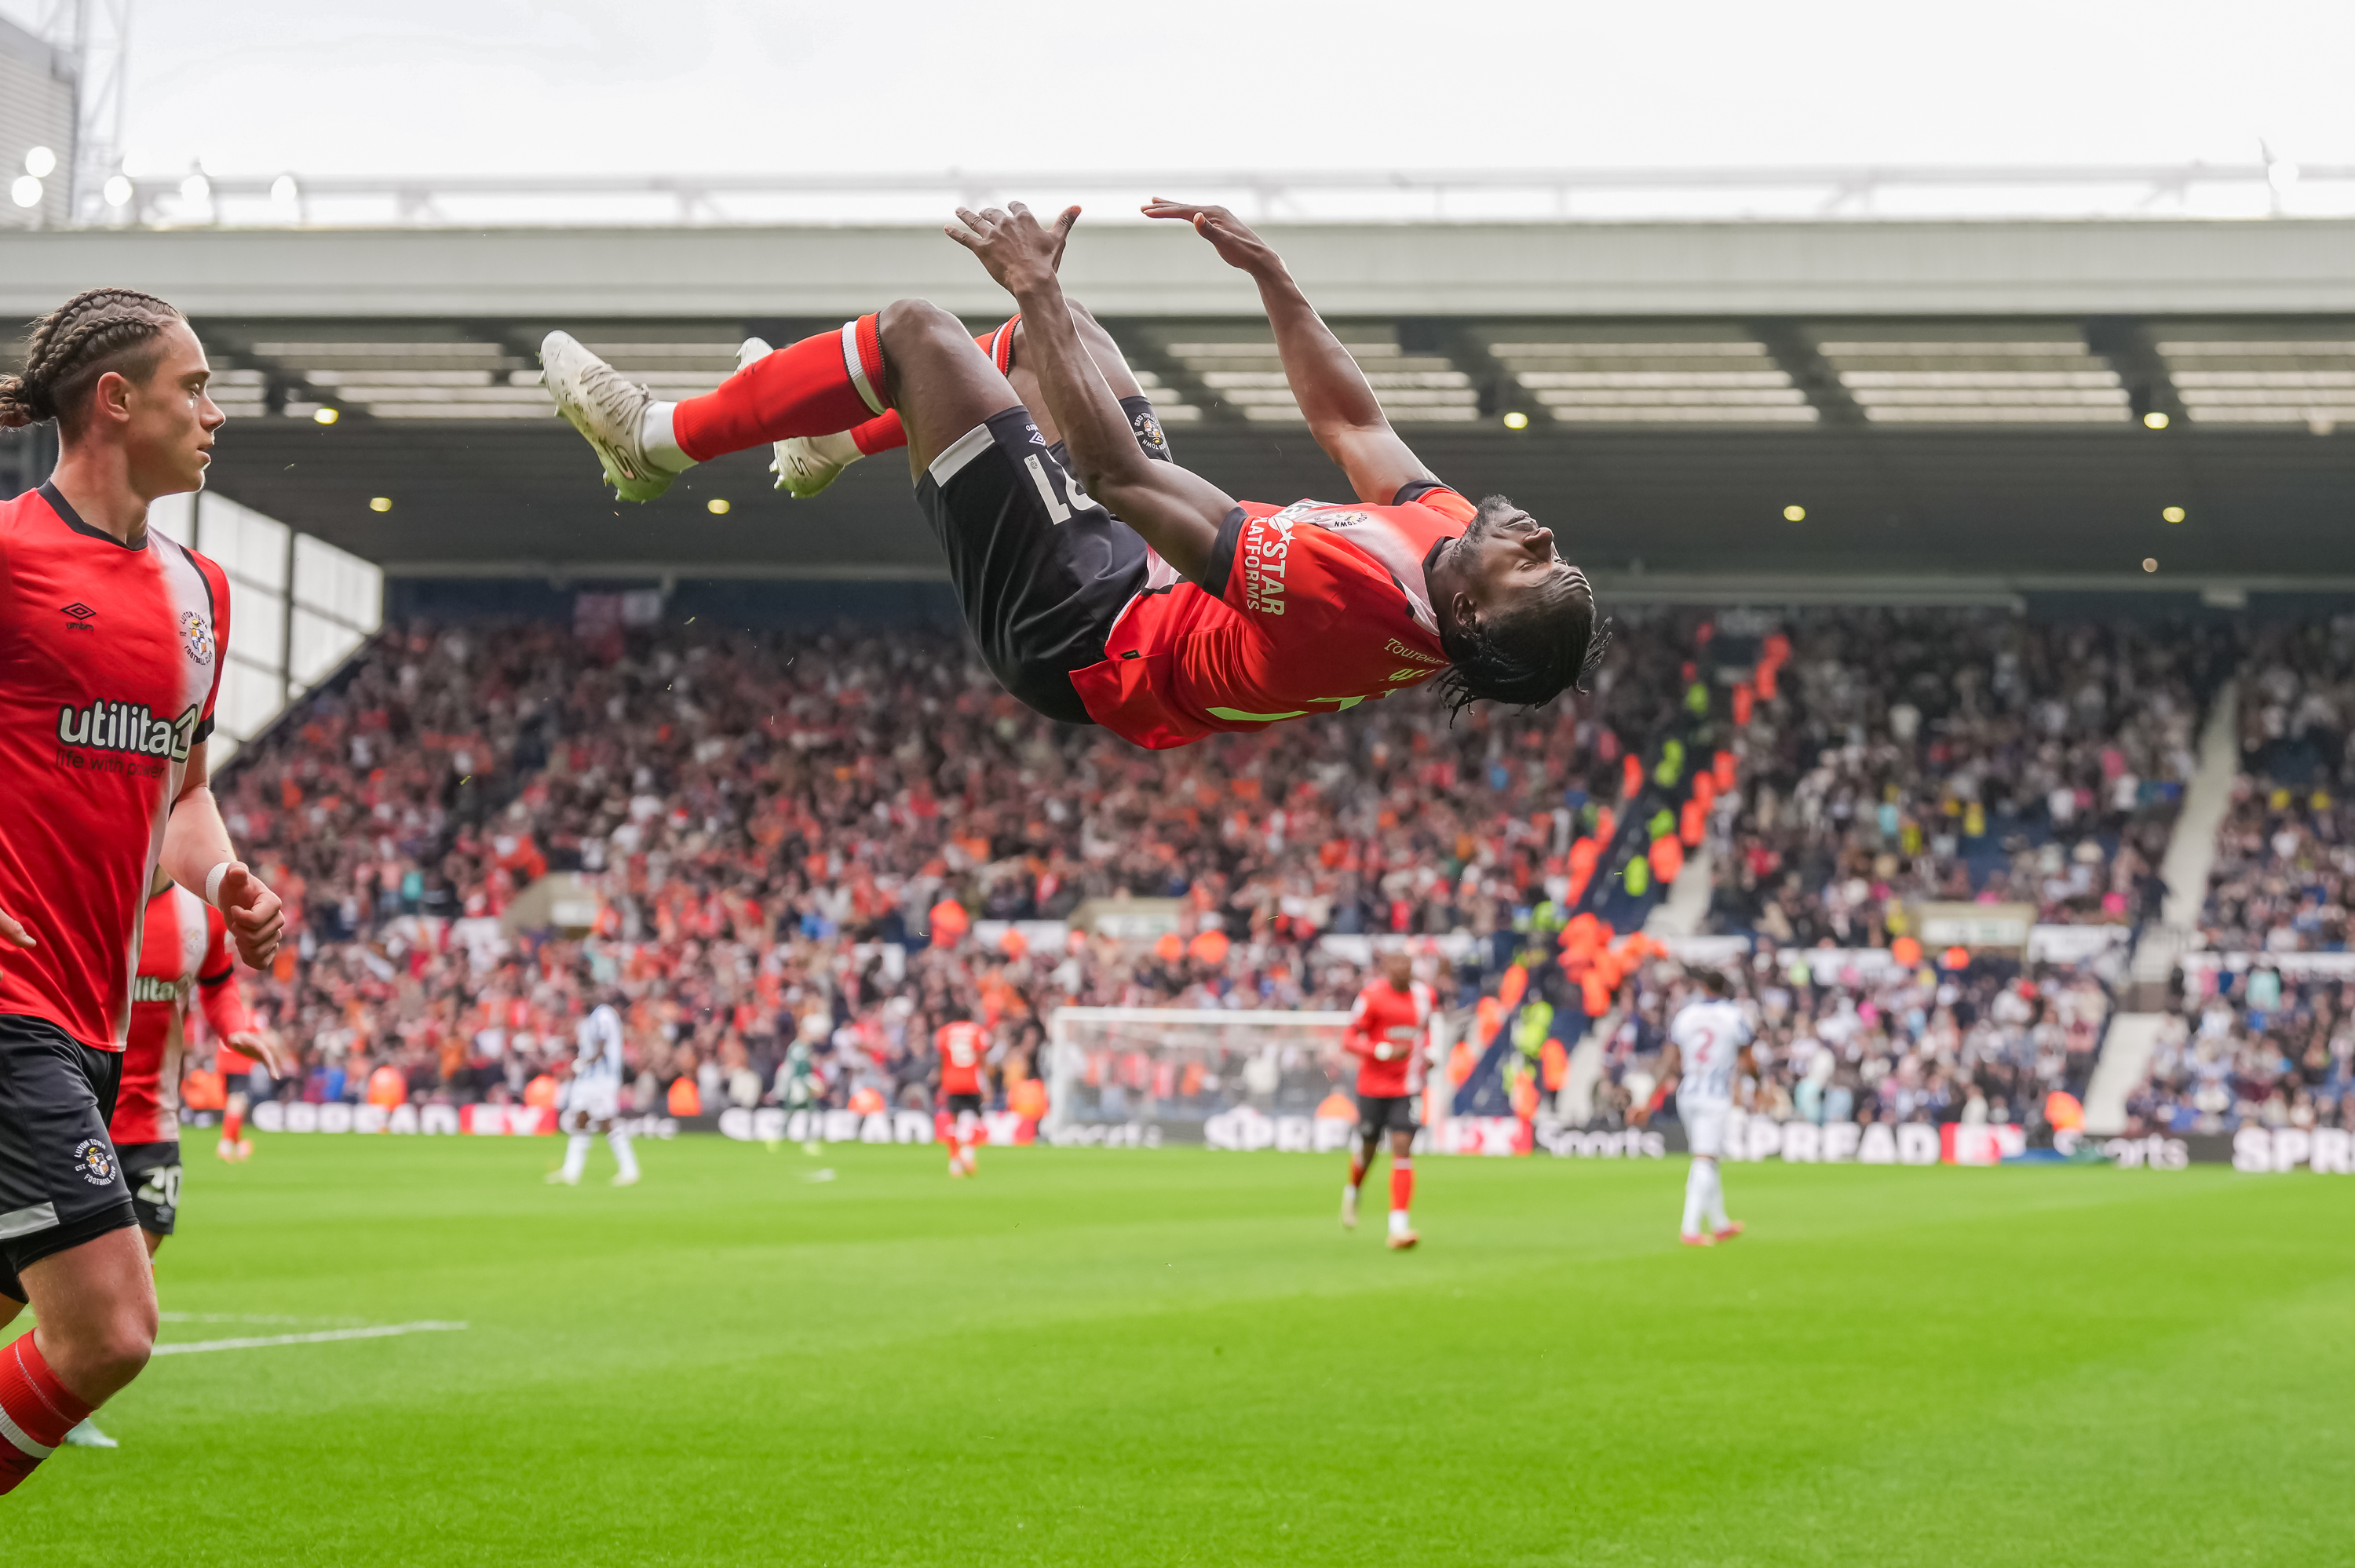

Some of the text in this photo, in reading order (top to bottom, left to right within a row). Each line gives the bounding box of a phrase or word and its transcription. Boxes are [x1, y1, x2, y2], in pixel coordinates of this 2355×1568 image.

[1141, 439, 1159, 450] TOWN
[1261, 541, 1287, 615] STAR
[180, 611, 193, 625] LUTON
[58, 699, 172, 758] utilita
[56, 748, 166, 779] life with power
[133, 976, 175, 1002] lita
[1695, 1026, 1715, 1063] 2
[74, 1140, 90, 1158] LUTON
[88, 1138, 106, 1150] TOWN
[2232, 1126, 2355, 1175] SPR
[75, 1163, 86, 1172] EST
[83, 1173, 112, 1186] FOOTBALL
[137, 1165, 183, 1209] 20
